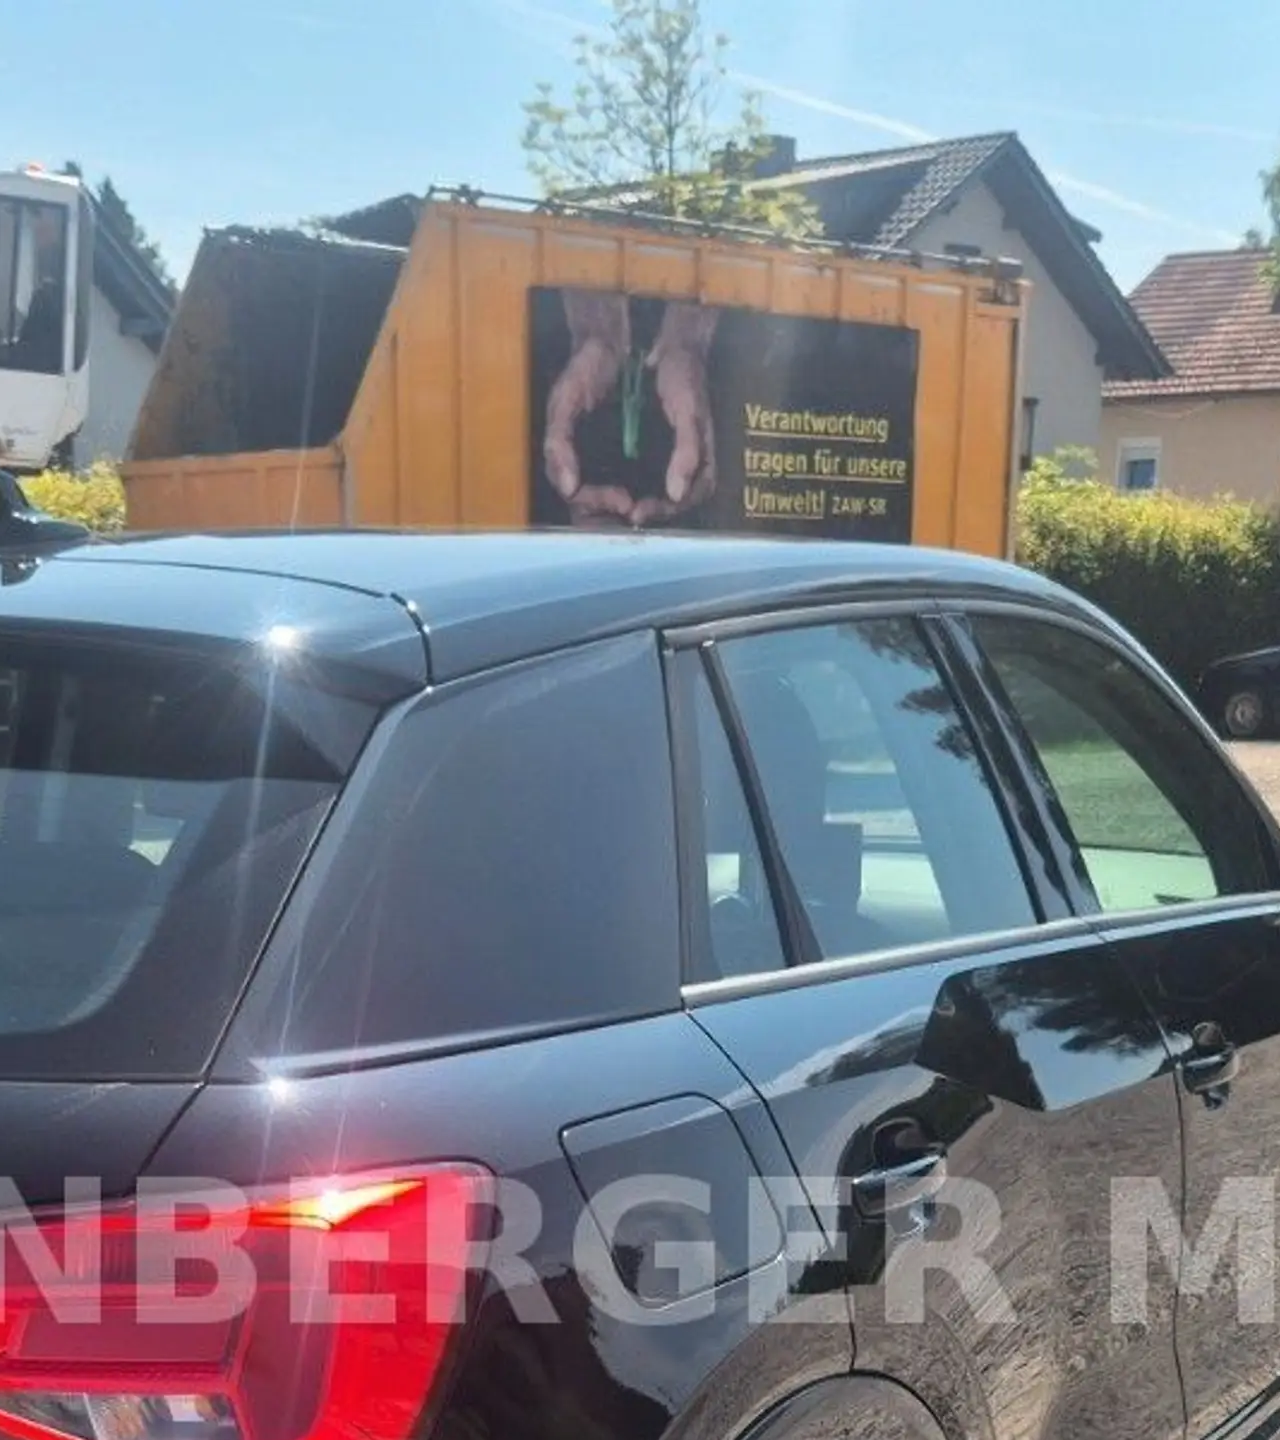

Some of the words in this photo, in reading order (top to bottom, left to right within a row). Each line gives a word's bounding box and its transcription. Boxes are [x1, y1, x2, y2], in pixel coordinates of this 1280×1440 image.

[744, 402, 889, 443] Verantwortung
[743, 448, 808, 479] tragen
[813, 449, 842, 473] für
[847, 455, 907, 479] unsere
[743, 485, 825, 515] Umwelt!
[831, 496, 887, 516] ZAW-SR
